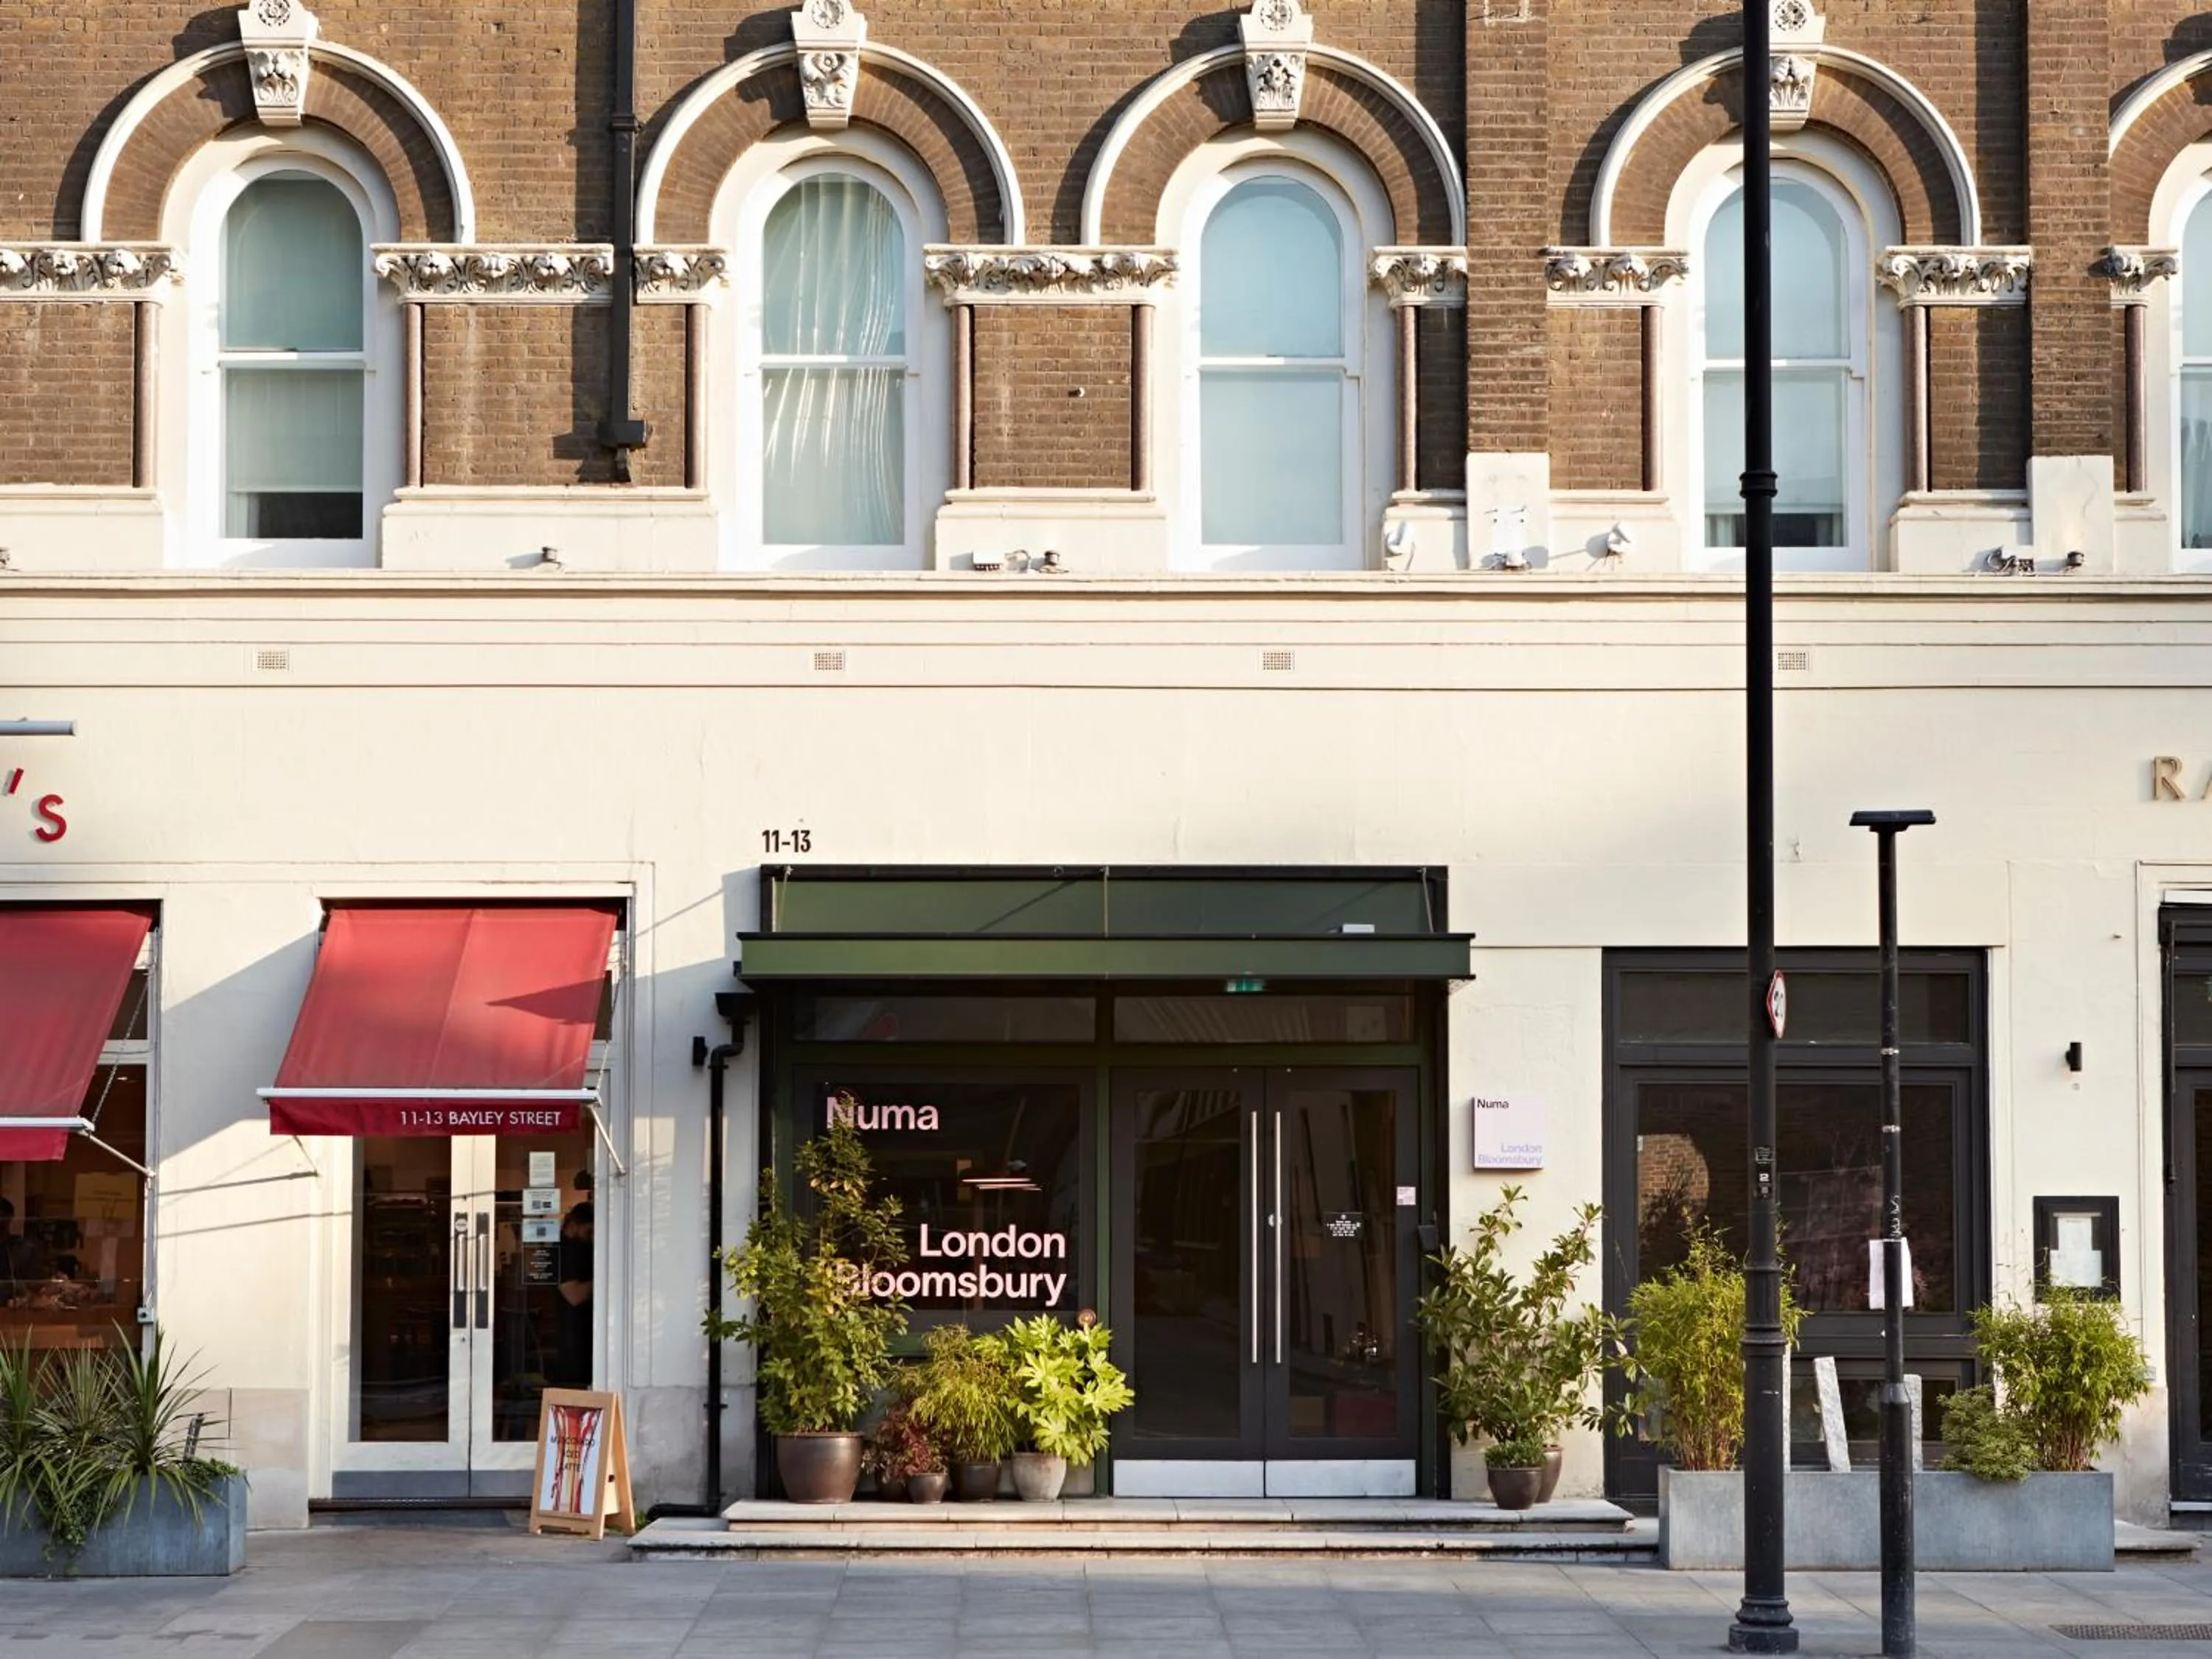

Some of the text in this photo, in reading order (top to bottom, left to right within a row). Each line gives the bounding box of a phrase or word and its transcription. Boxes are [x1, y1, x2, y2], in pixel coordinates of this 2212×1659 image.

[762, 830, 812, 852] 11-13
[1477, 1099, 1509, 1108] Numa
[400, 1111, 561, 1126] 11-13 BAYLEY STREET
[827, 1096, 939, 1130] Numa
[1501, 1143, 1542, 1153] London
[1478, 1154, 1543, 1166] Bloomsbury
[919, 1223, 1065, 1258] London
